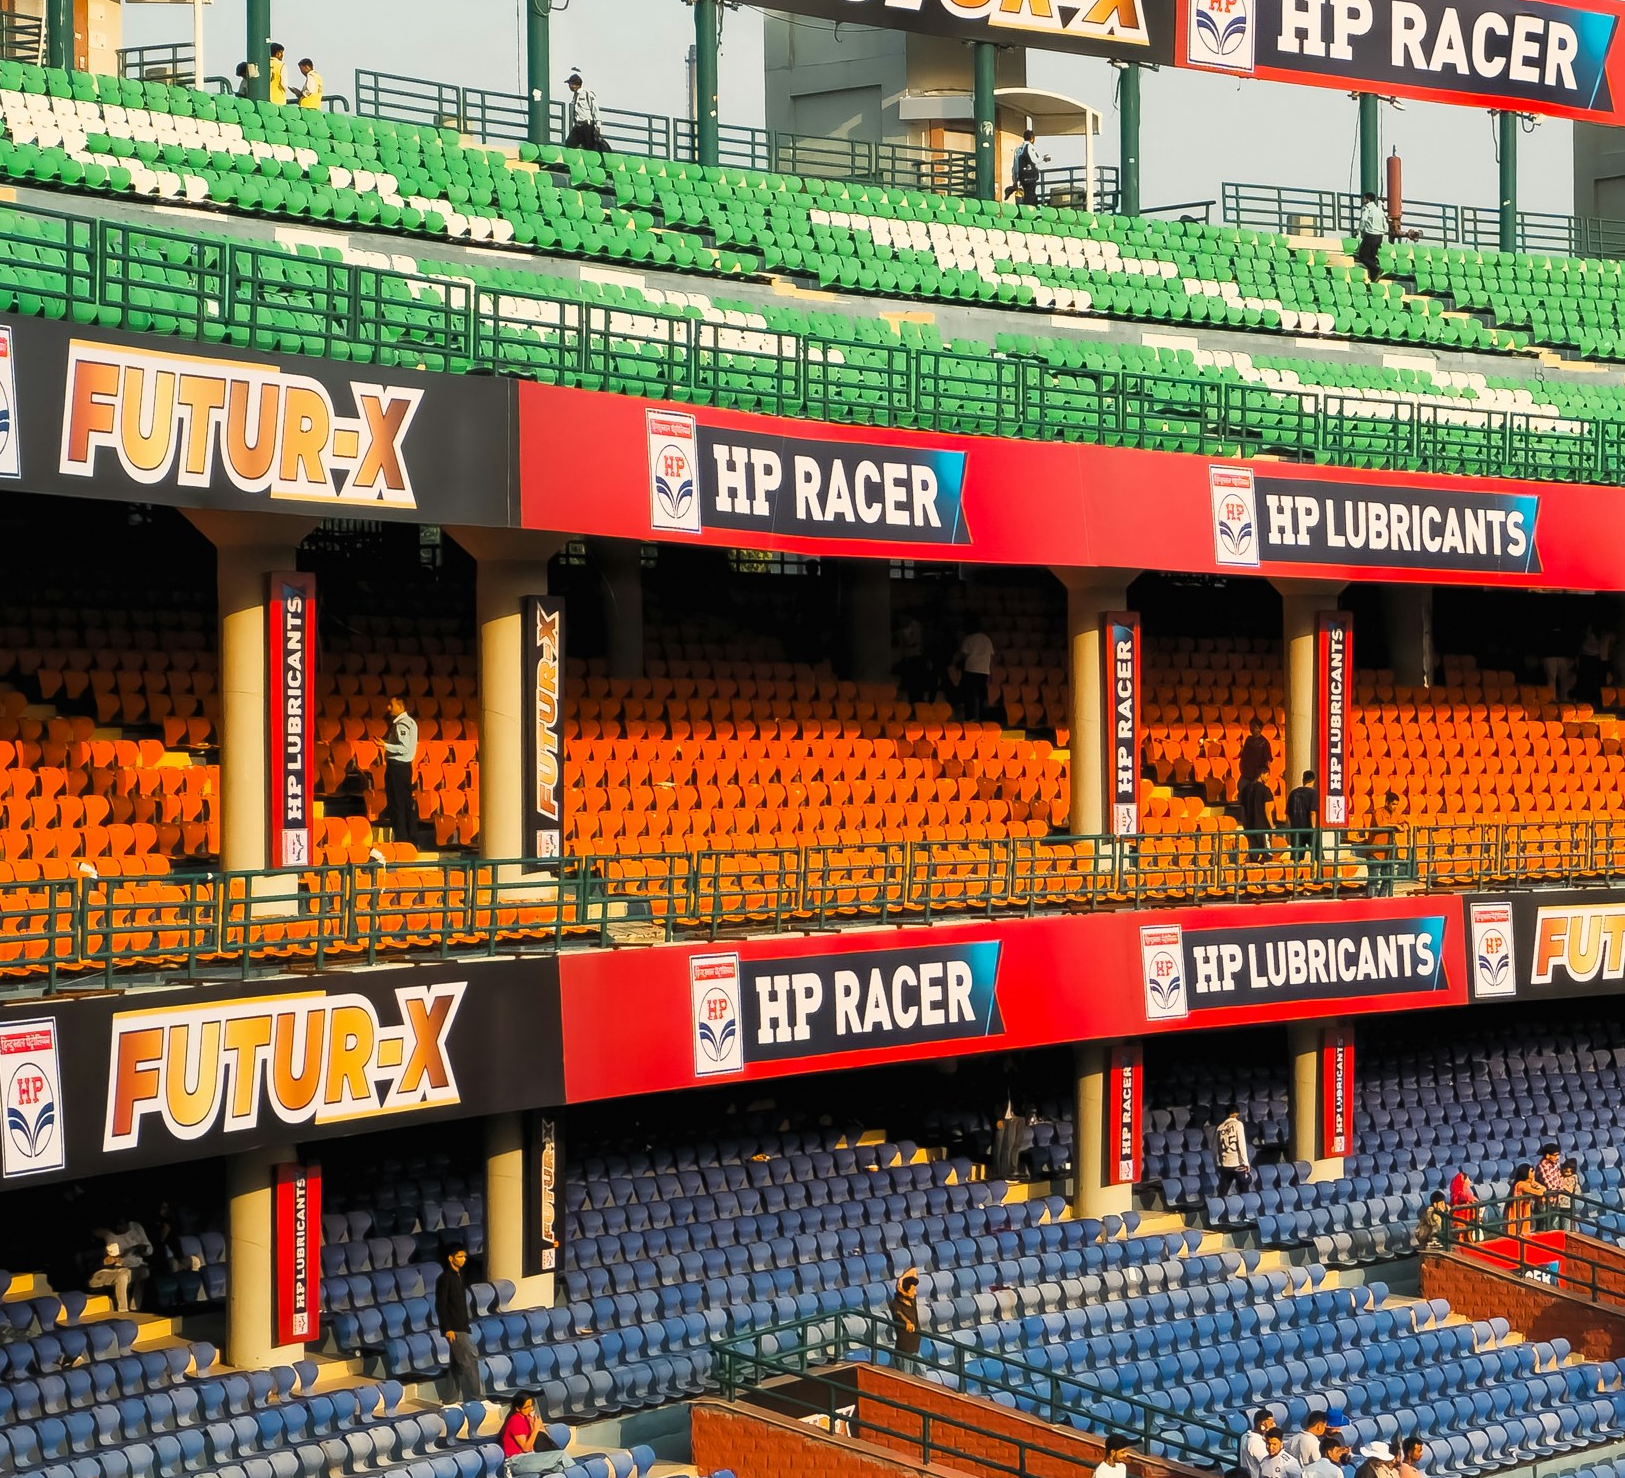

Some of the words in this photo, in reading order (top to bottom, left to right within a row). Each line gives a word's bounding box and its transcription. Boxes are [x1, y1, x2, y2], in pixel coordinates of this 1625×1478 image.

[1391, 0, 1578, 90] RACER
[64, 349, 417, 500] FUTUR-X
[664, 455, 685, 478] HP
[713, 444, 782, 516] HP
[794, 455, 942, 528] RACER
[1226, 503, 1244, 522] HP
[1266, 495, 1320, 546] HP
[1325, 499, 1526, 557] LUBRICANTS
[287, 596, 302, 770] LUBRICANTS
[537, 605, 559, 819] FUTUR-X
[1117, 640, 1133, 739] RACER
[1330, 628, 1343, 754] LUBRICANTS
[1118, 746, 1132, 793] HP
[1330, 757, 1343, 790] HP
[287, 783, 302, 821] HP
[1193, 944, 1243, 994] HP
[1248, 933, 1435, 989] LUBRICANTS
[707, 998, 727, 1021] HP
[755, 972, 823, 1045] HP
[834, 960, 976, 1035] RACER
[16, 1076, 44, 1105] HP
[107, 988, 460, 1144] FUTUR-X
[1122, 1066, 1132, 1123] RACER
[296, 1178, 306, 1278] LUBRICANTS
[296, 1280, 305, 1309] HP
